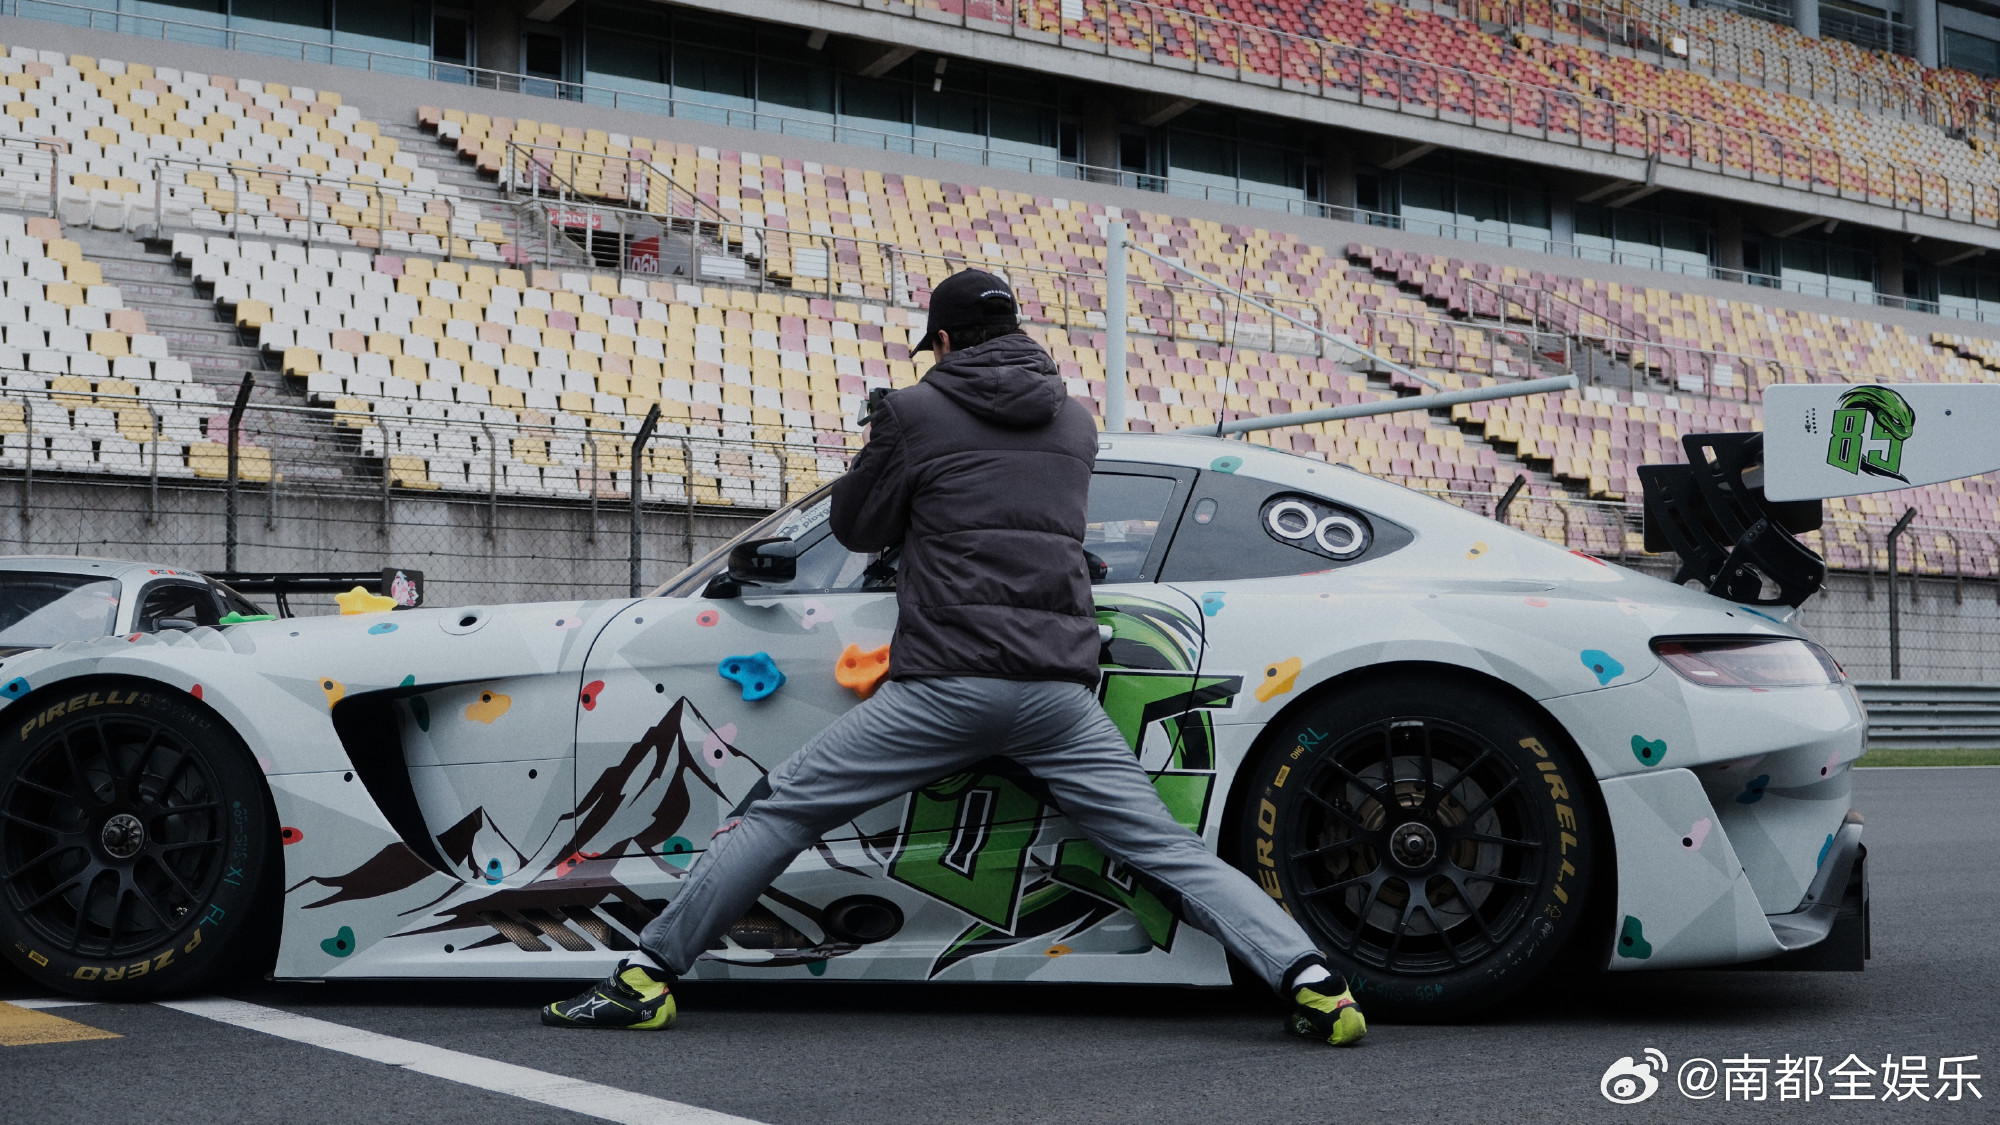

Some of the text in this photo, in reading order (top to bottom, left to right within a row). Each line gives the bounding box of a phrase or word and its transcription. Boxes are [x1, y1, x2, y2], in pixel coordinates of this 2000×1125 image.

[1826, 408, 1904, 476] 85
[802, 506, 832, 529] playg
[20, 689, 140, 742] PIRELLI
[1297, 727, 1329, 753] RL
[1518, 736, 1578, 905] PIRELLI
[1256, 797, 1293, 919] ERO
[199, 903, 226, 926] FL
[184, 928, 202, 954] P
[73, 948, 175, 982] ZERO
